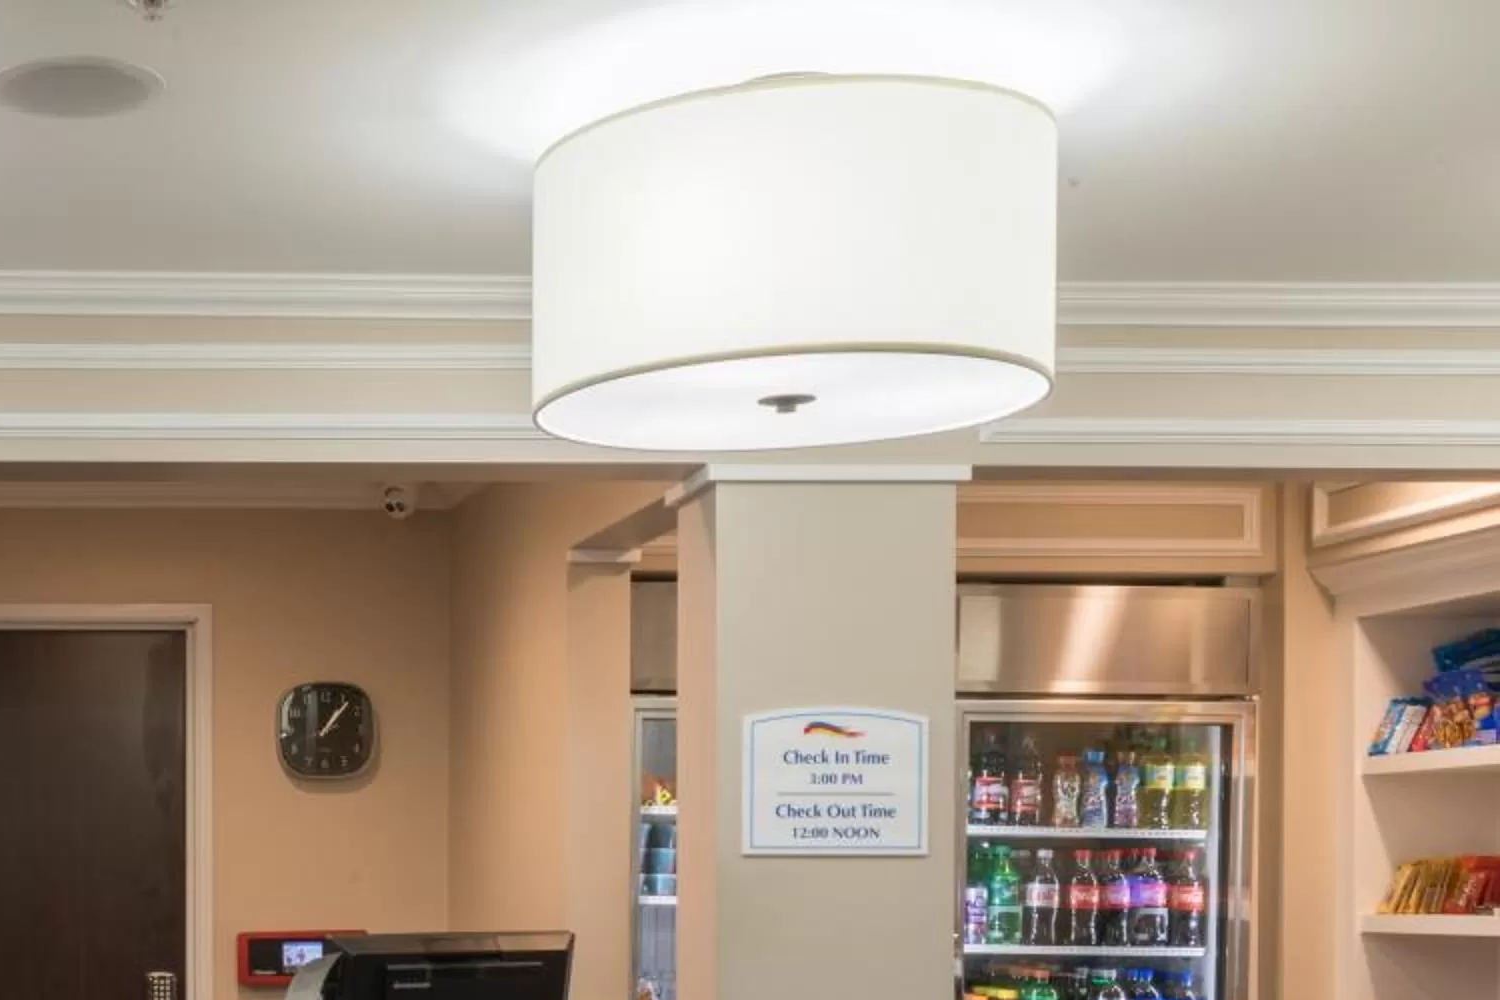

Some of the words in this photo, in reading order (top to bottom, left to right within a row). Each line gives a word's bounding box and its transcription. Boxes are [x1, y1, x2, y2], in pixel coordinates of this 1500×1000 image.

[783, 749, 829, 765] Check
[835, 750, 850, 764] In
[854, 749, 890, 765] Time
[809, 772, 837, 785] 3:00
[841, 773, 863, 785] PM
[775, 803, 821, 819] Check
[827, 804, 857, 819] Out
[861, 803, 896, 819] Time
[792, 827, 829, 839] 12:00
[833, 827, 881, 839] NOON
